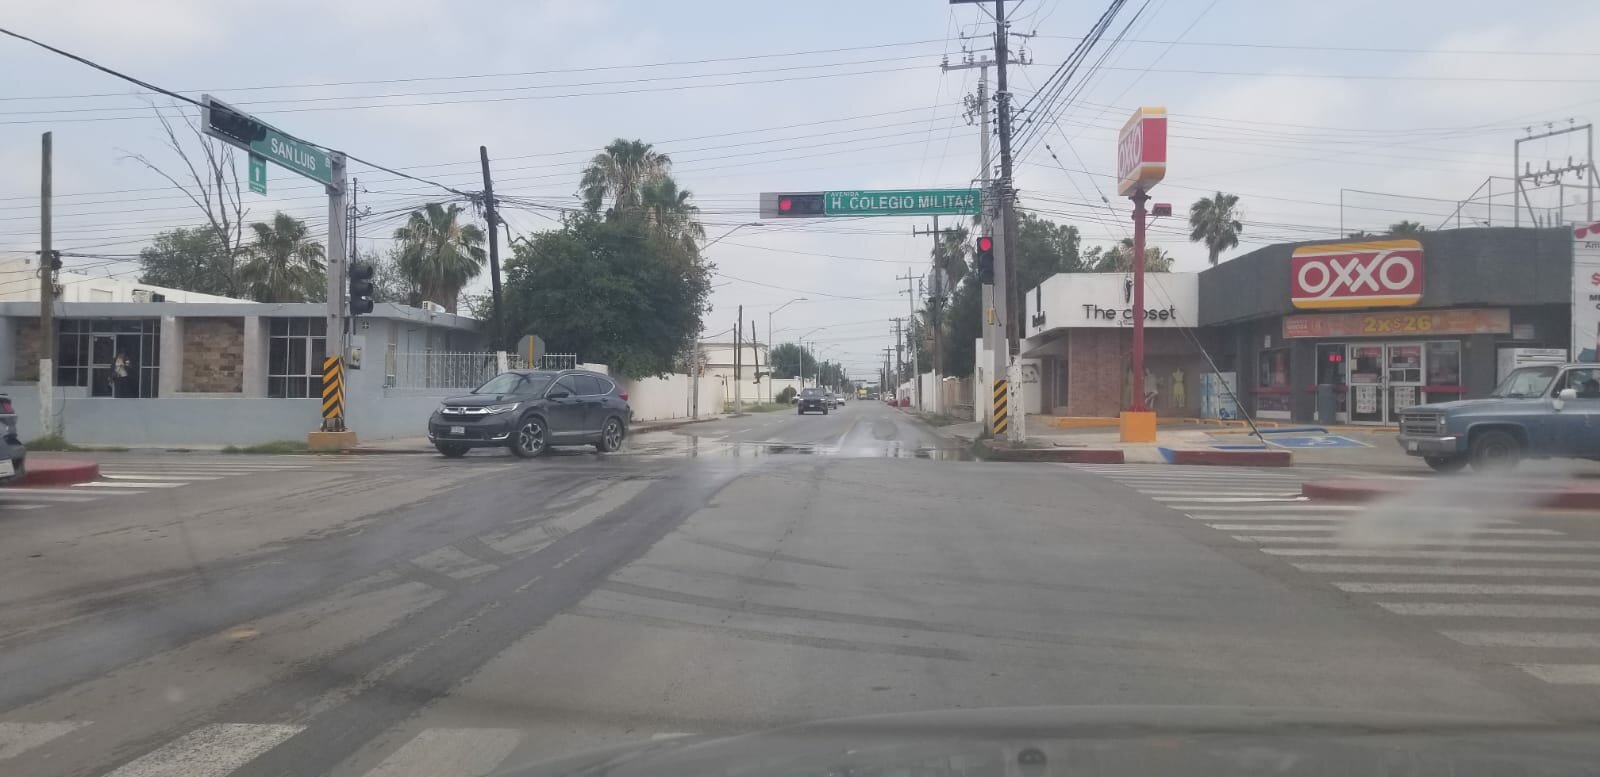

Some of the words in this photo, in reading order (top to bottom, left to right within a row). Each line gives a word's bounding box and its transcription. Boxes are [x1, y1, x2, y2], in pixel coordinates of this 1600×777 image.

[271, 138, 293, 161] SAN
[294, 150, 316, 170] LUIS
[1118, 126, 1142, 179] OXXO
[832, 197, 845, 210] H.
[849, 196, 914, 210] COLEGIO
[918, 194, 975, 209] MILITAR
[1298, 255, 1414, 296] OXXO
[1082, 304, 1116, 320] The
